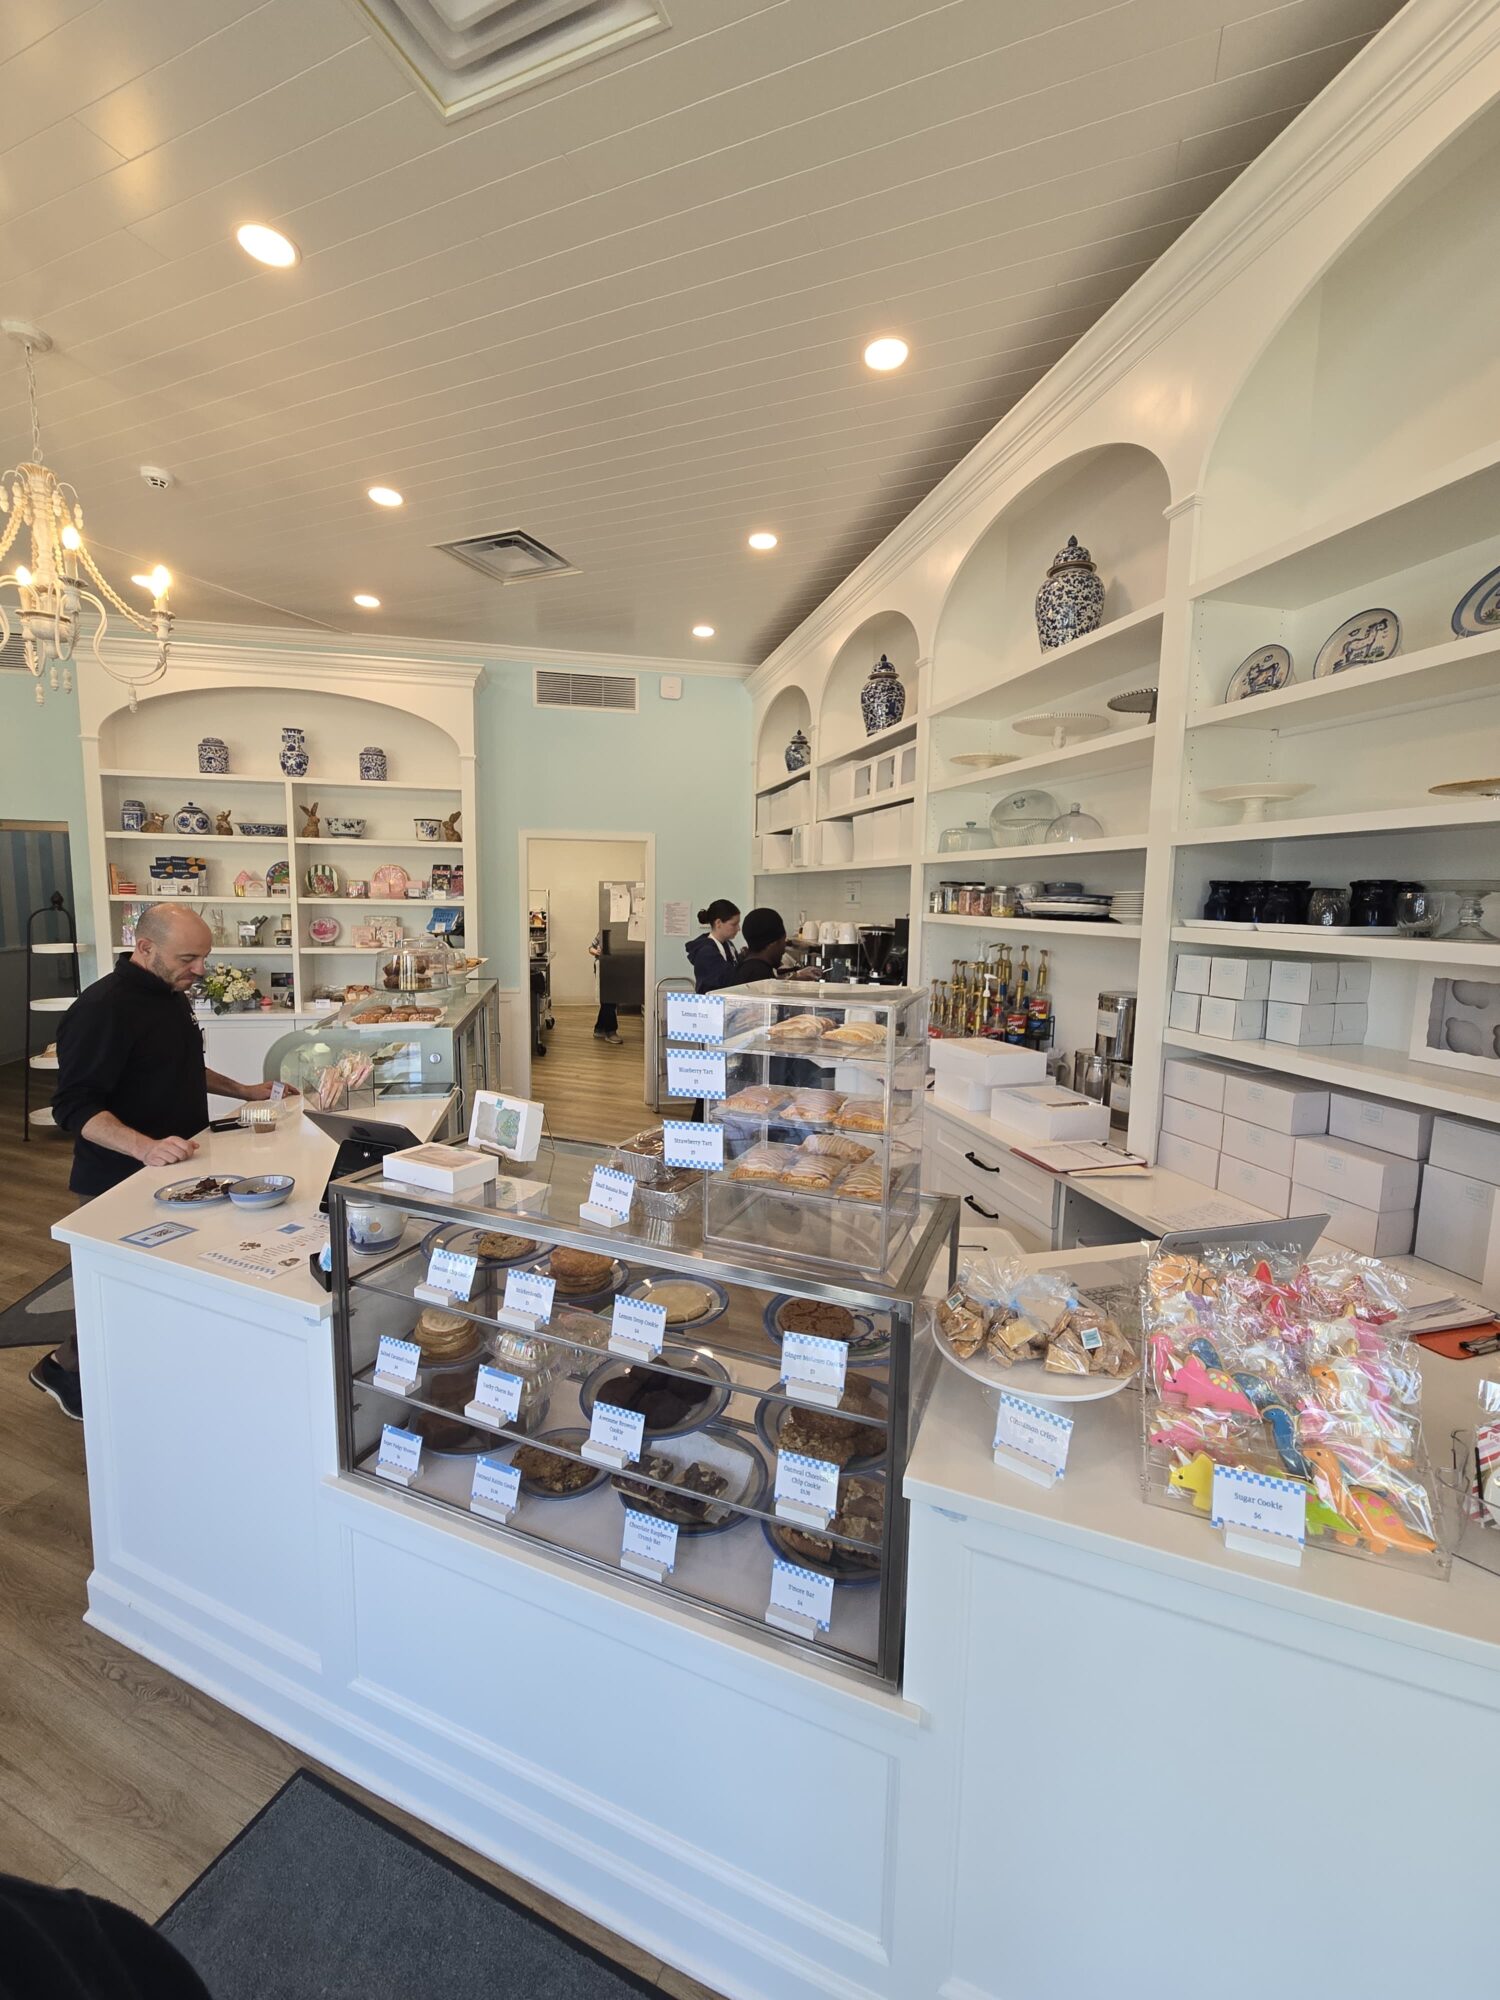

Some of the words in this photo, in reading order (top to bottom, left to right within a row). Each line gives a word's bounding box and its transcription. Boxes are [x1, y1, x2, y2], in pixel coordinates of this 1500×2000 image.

[681, 1010, 697, 1018] Lemon
[674, 1137, 701, 1146] Strawberry
[618, 1312, 632, 1321] Lemon
[633, 1316, 643, 1326] Drop
[644, 1319, 659, 1329] Cookie
[784, 1351, 802, 1361] Ginger
[599, 1415, 618, 1424] Awesome
[619, 1420, 637, 1430] Brownie
[1009, 1415, 1039, 1434] Cinnamon
[609, 1426, 624, 1436] Cookie
[783, 1464, 805, 1477] Oatmeal
[791, 1476, 804, 1488] Chip
[803, 1480, 822, 1491] Cookie
[1234, 1492, 1256, 1504] Sugar
[1257, 1498, 1284, 1511] Cookie
[1253, 1511, 1262, 1520] $6
[629, 1521, 650, 1532] Chocolate
[650, 1528, 673, 1543] Raspberry
[638, 1533, 652, 1543] Crumb
[652, 1538, 661, 1547] Bar
[806, 1589, 816, 1599] Bar
